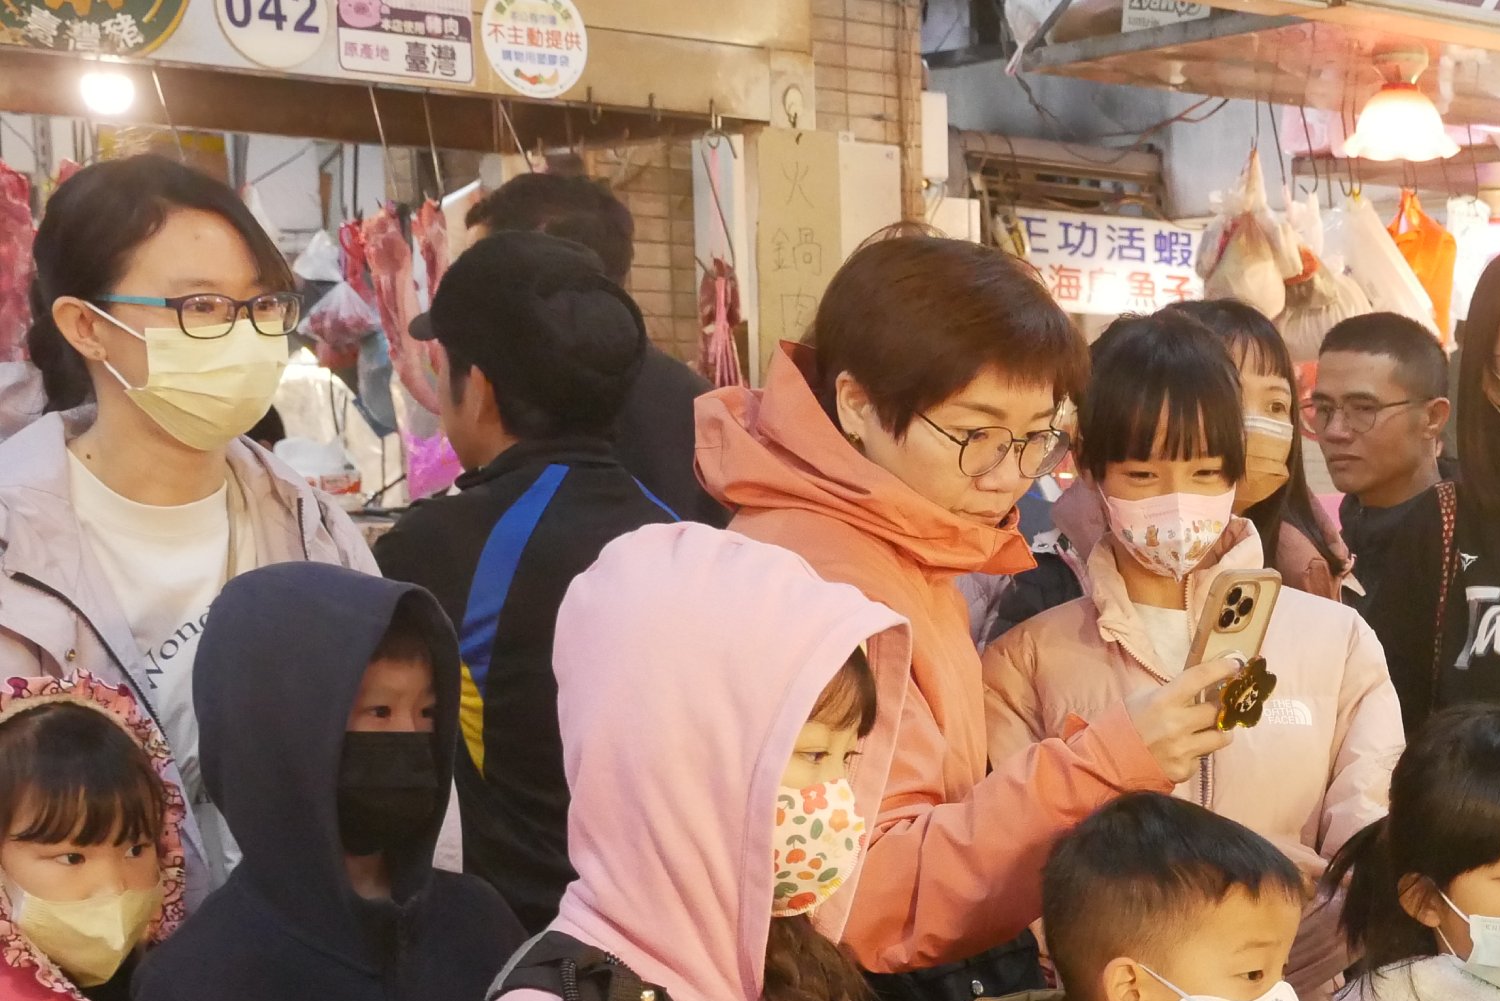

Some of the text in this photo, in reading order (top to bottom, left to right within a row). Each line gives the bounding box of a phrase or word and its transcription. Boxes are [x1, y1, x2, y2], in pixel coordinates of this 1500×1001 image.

[487, 22, 583, 52] 不主動提供
[344, 41, 456, 77] 原產地 臺灣
[1263, 708, 1296, 717] ORTH
